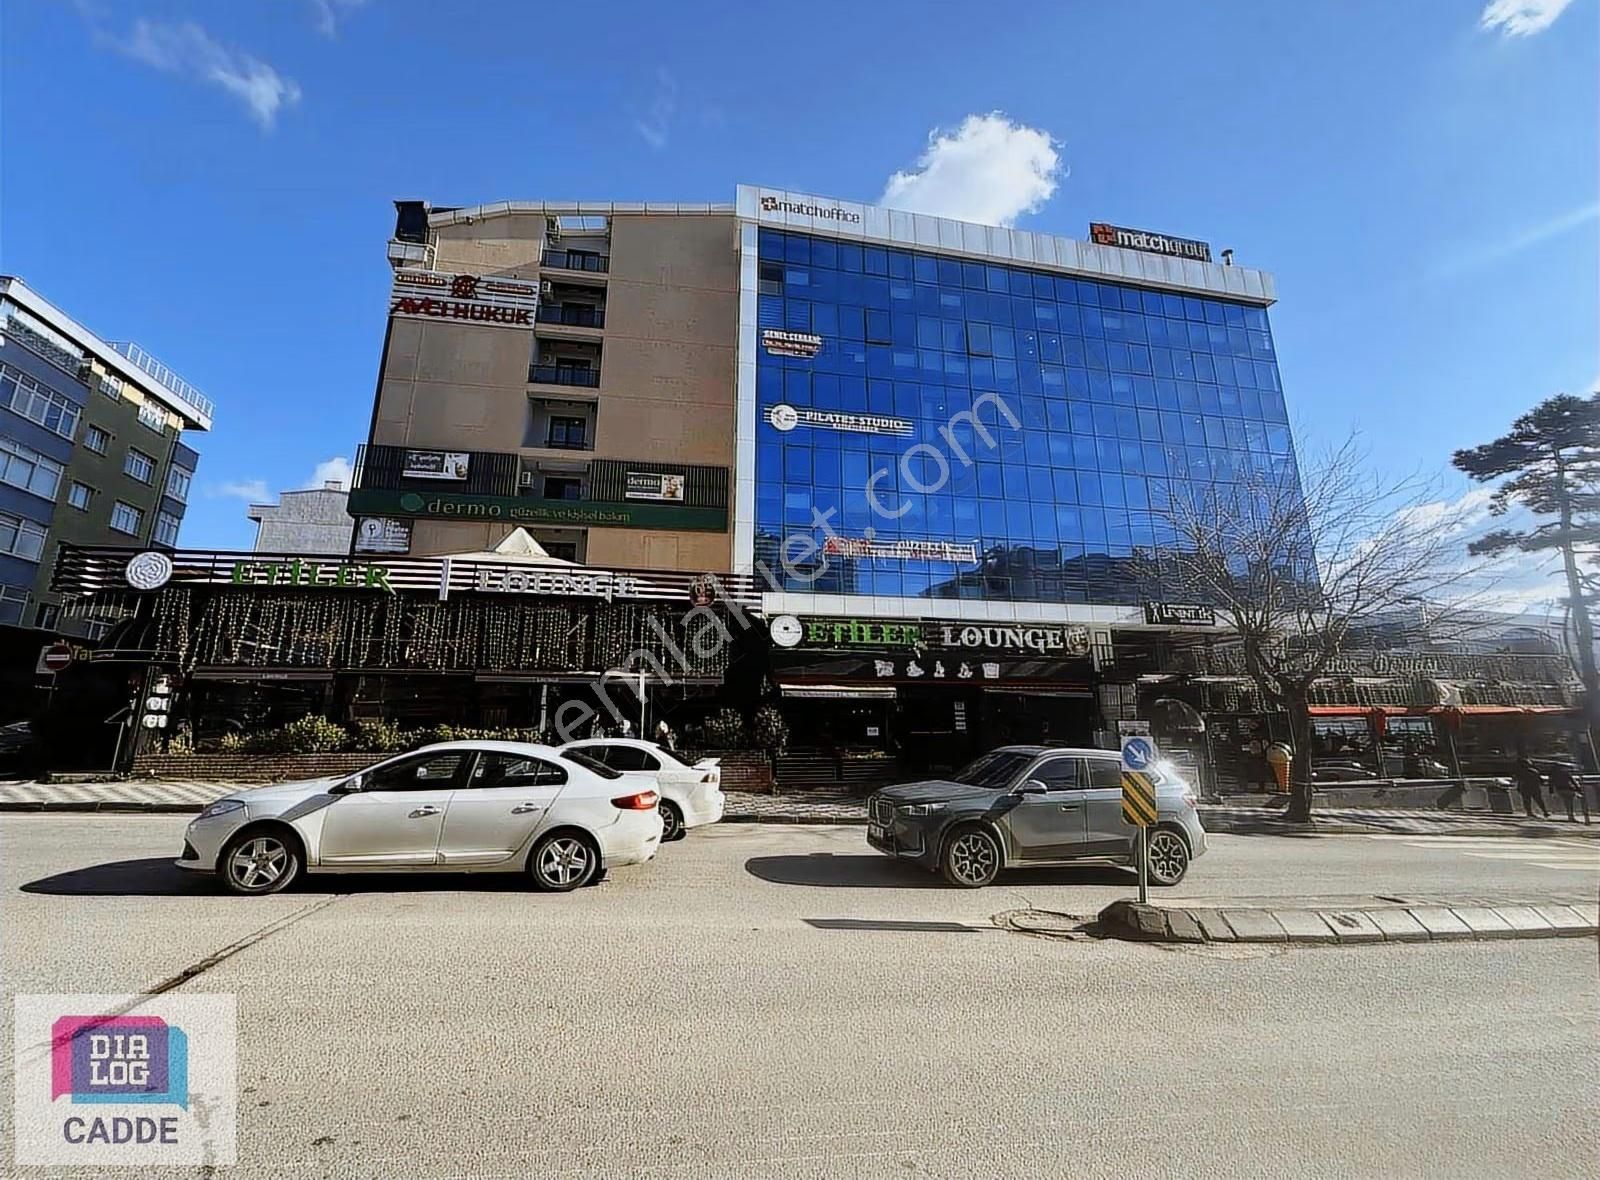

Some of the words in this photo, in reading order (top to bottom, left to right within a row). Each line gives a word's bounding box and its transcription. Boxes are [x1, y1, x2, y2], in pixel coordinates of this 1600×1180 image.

[778, 200, 860, 224] matchoffice
[427, 498, 501, 517] dermo
[475, 570, 639, 603] LOUNGE
[940, 625, 1064, 653] LOUNGE
